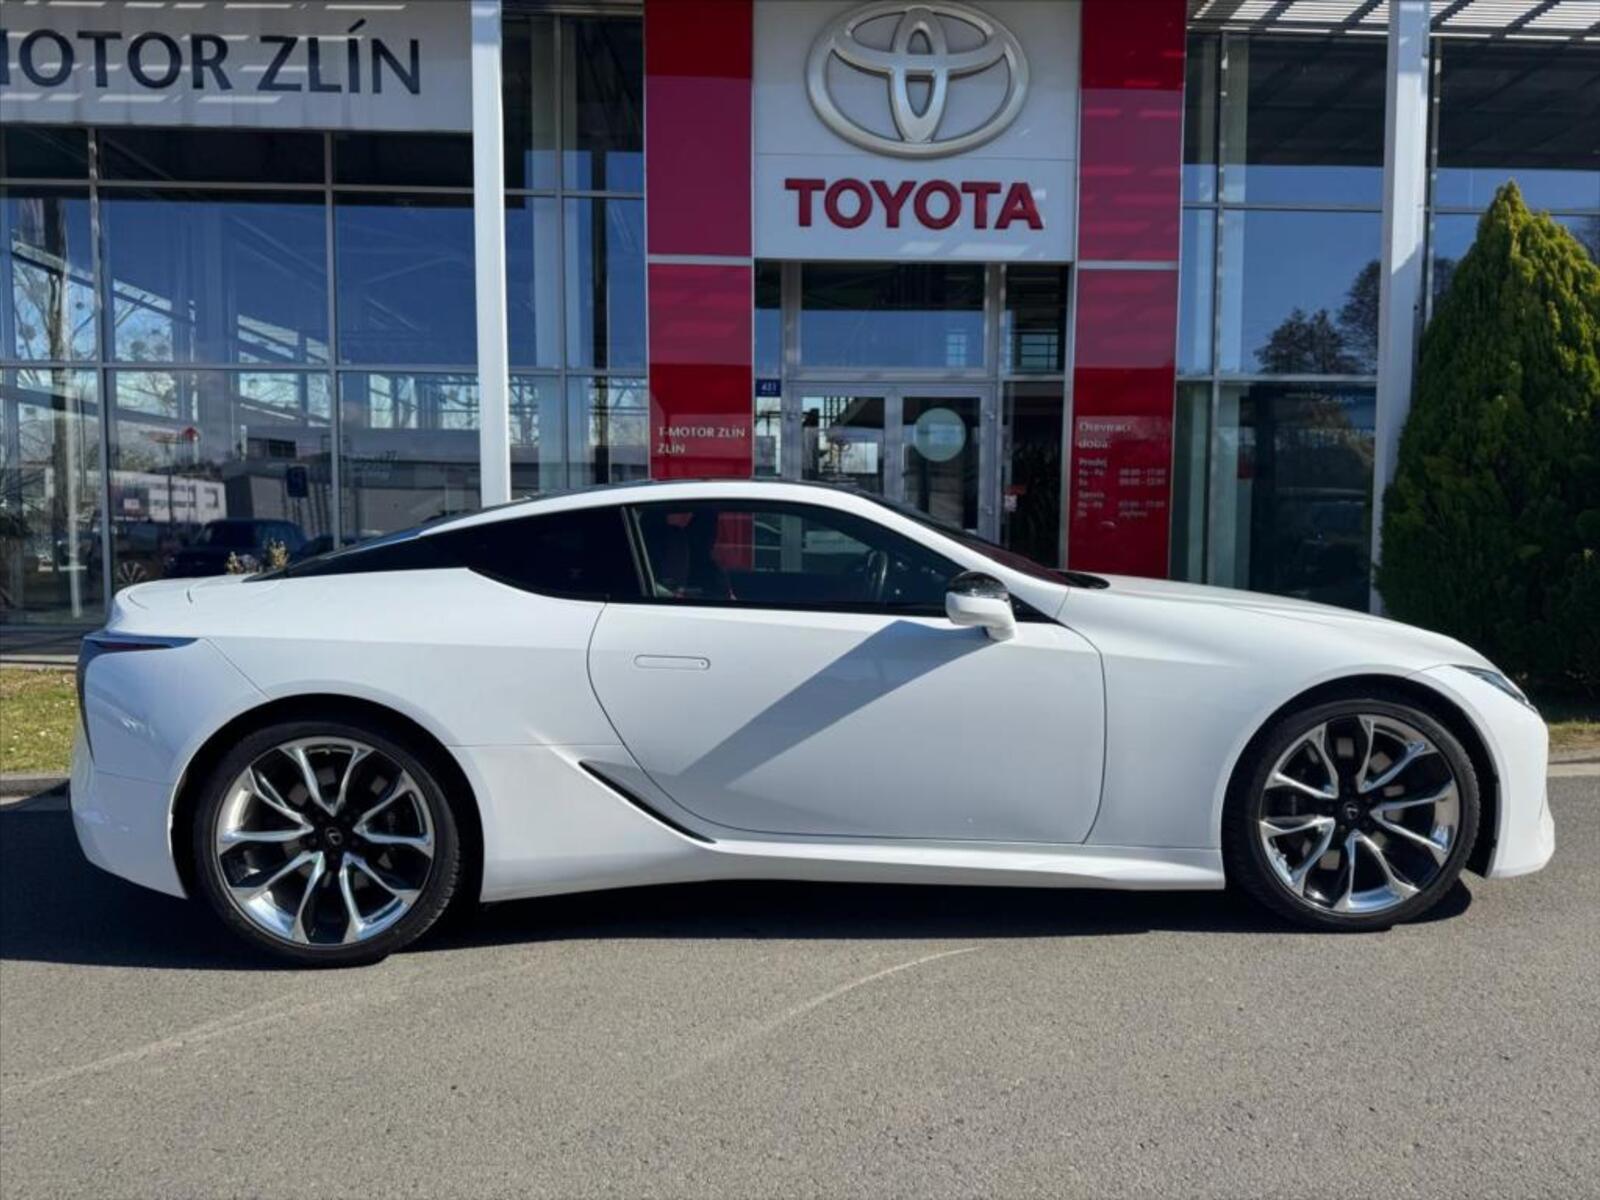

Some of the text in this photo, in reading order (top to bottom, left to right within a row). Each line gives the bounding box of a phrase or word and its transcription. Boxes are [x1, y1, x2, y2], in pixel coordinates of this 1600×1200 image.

[0, 18, 421, 95] OTOR ZLÍN
[784, 178, 1044, 230] TOYOTA
